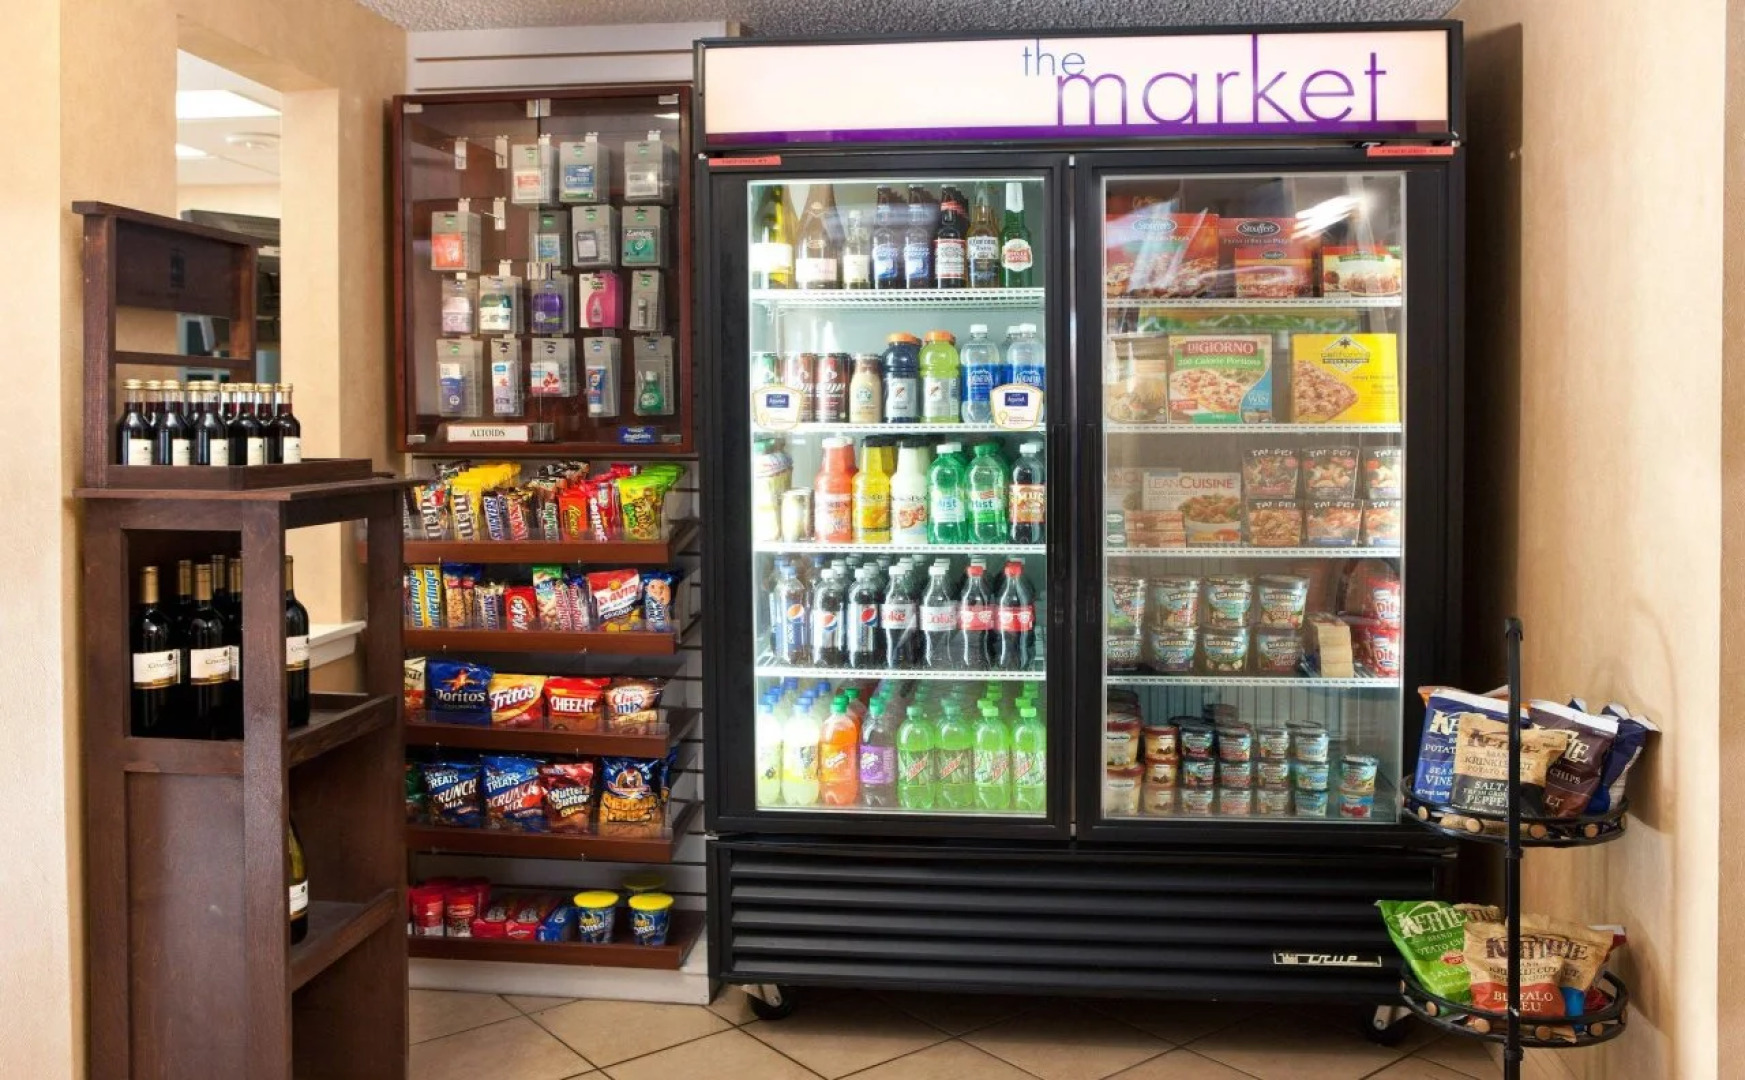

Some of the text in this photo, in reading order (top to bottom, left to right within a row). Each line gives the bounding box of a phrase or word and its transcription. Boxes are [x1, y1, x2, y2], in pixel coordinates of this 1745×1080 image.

[1023, 38, 1085, 77] the
[1057, 34, 1388, 124] market
[1242, 223, 1275, 233] Stouffer's
[470, 429, 506, 438] ALTOIDS
[409, 569, 422, 628] utterfinger
[425, 569, 440, 628] utterfinger
[435, 688, 486, 703] Doritos
[490, 686, 535, 712] Fritos
[1424, 744, 1457, 753] POTAT
[1425, 775, 1453, 786] VINE
[1466, 794, 1508, 807] PEPPE
